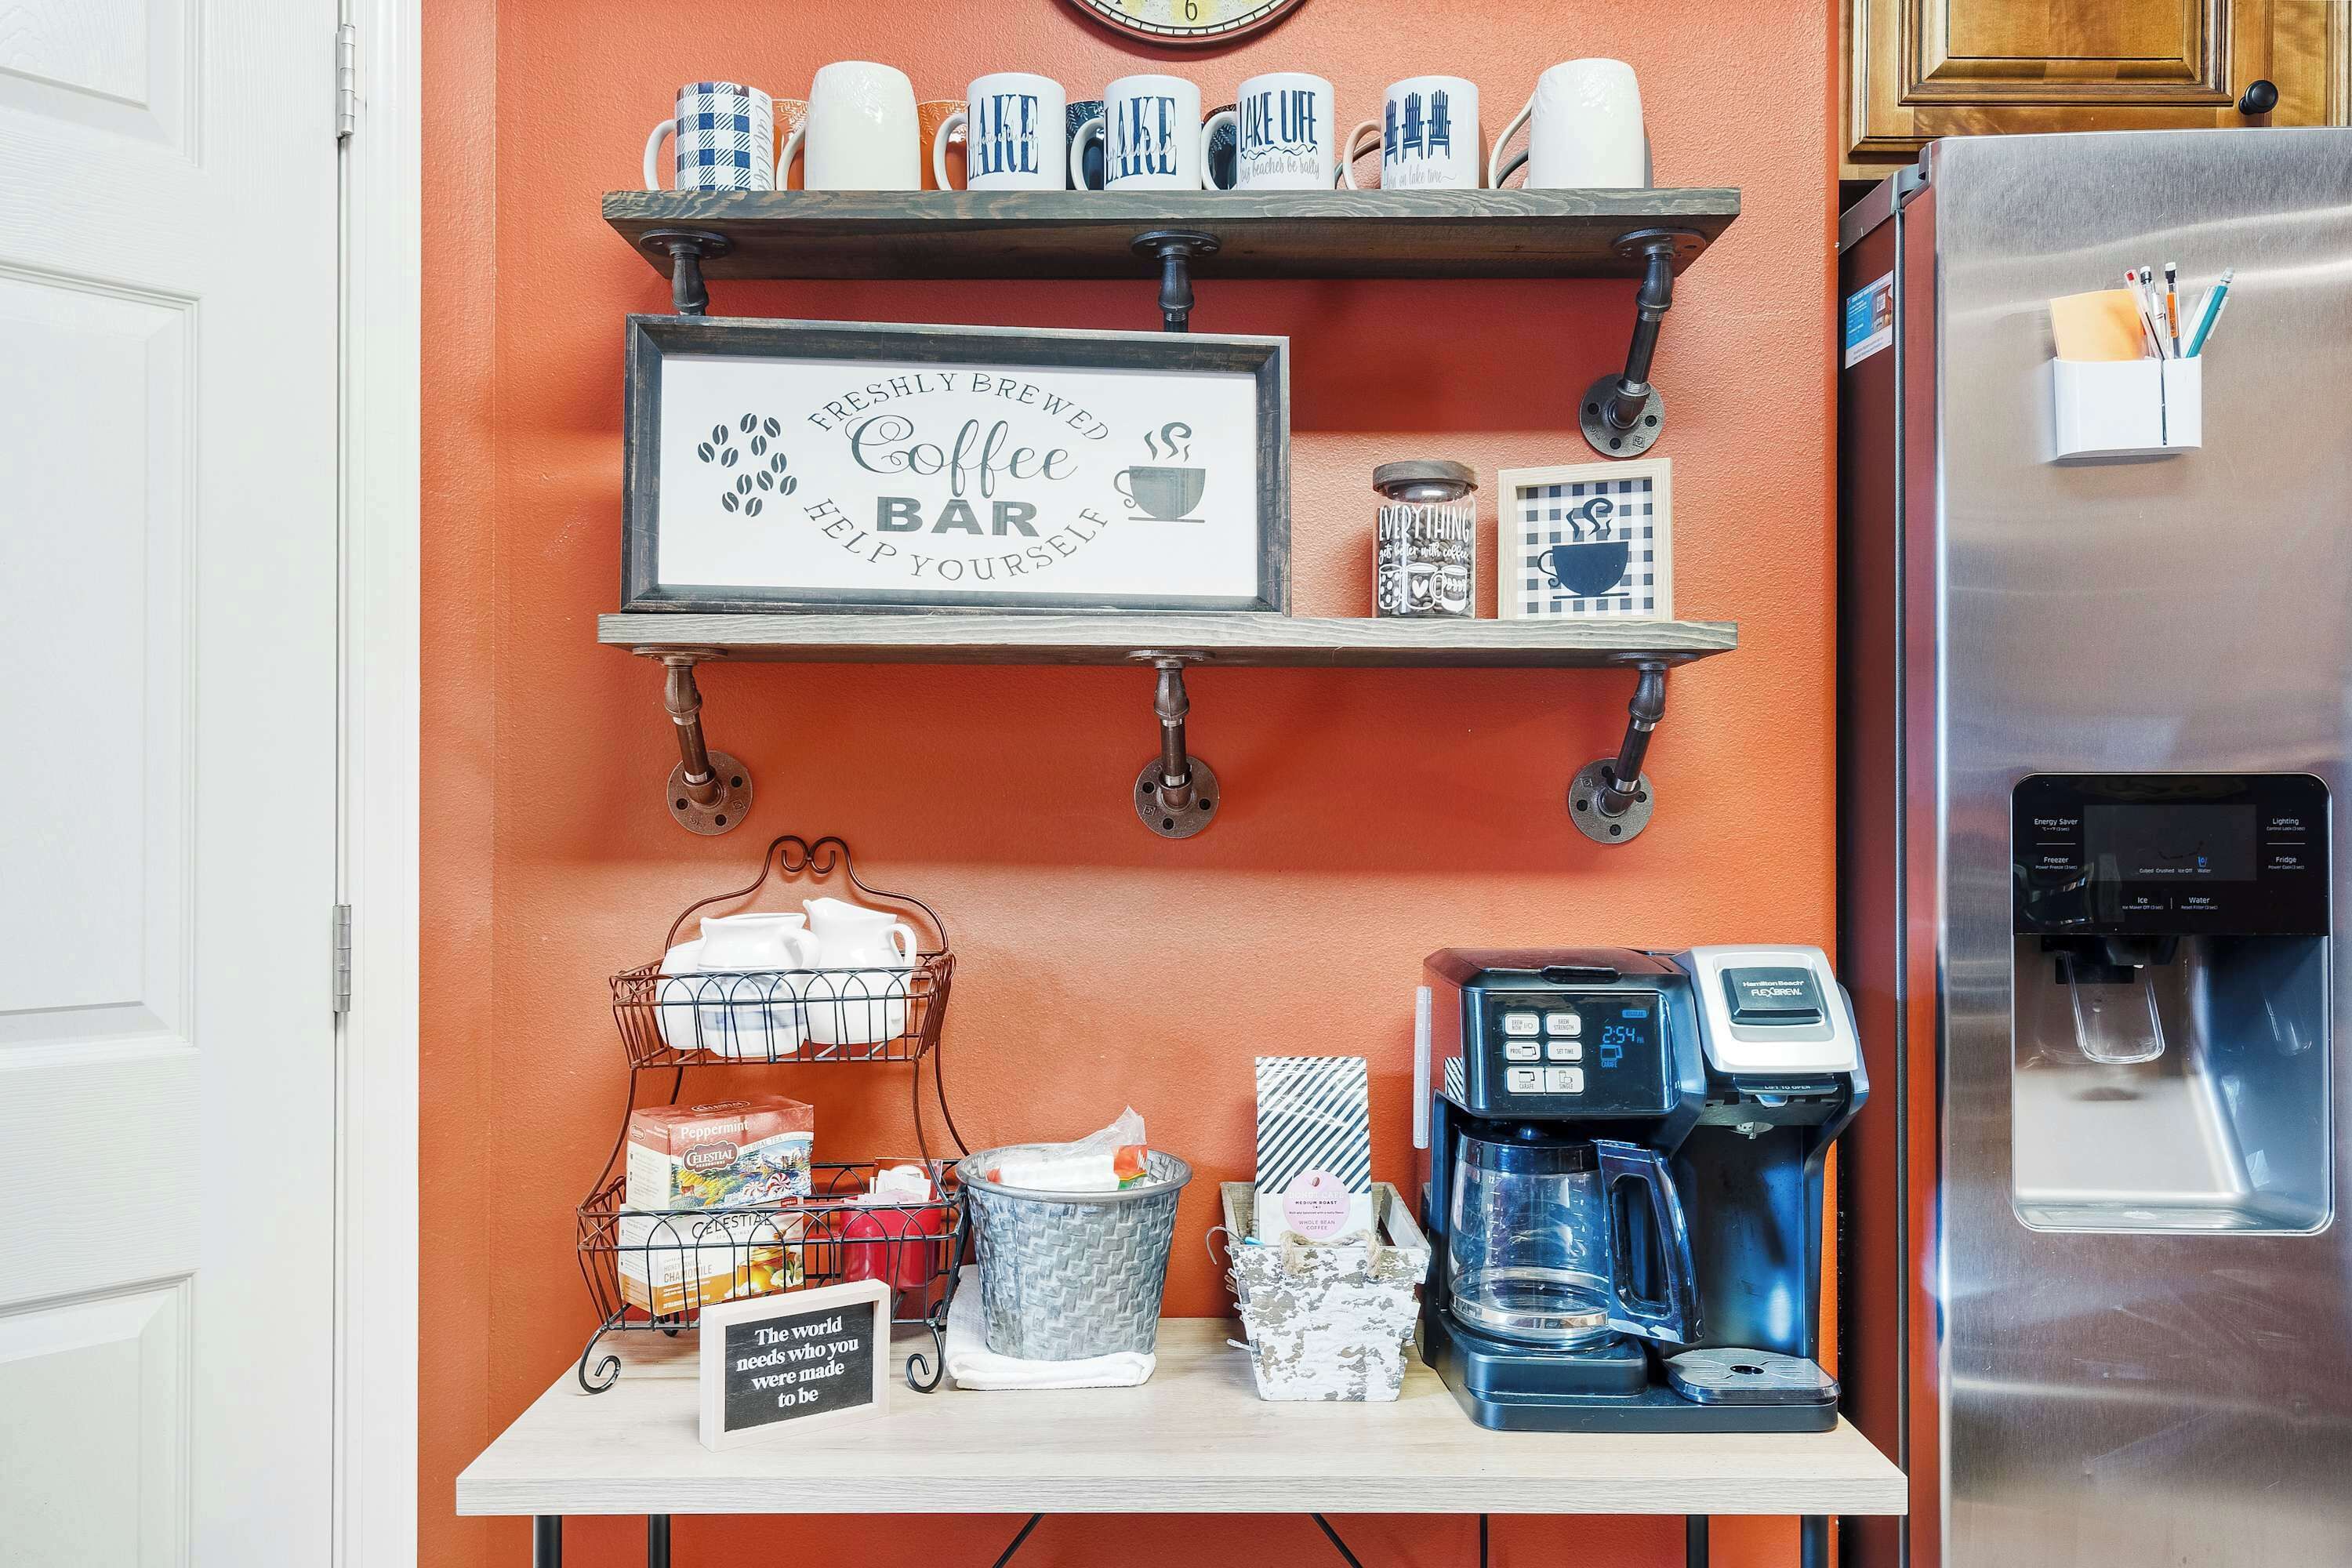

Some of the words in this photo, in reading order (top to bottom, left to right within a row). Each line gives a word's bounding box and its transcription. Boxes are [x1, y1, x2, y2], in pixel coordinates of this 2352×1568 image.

[1185, 0, 1197, 20] 6
[968, 94, 1039, 181] LAKE
[1240, 92, 1274, 153] LAKE
[1281, 90, 1318, 145] LIFE
[1104, 96, 1176, 186] LAKE
[1287, 156, 1298, 172] be
[808, 373, 958, 432] FRESHLY
[972, 372, 1109, 441] BREWED
[845, 415, 1078, 499] Coffee
[877, 496, 1040, 537] BAR
[1378, 504, 1470, 543] EVERYTHING
[804, 499, 897, 564] HELP
[909, 508, 1109, 581] YOURSELF
[1378, 543, 1393, 564] gets
[1394, 542, 1420, 557] better
[1421, 540, 1443, 558] with
[1443, 543, 1469, 561] coffee
[1602, 1026, 1635, 1044] 2:54
[681, 1120, 750, 1140] Peppermint
[687, 1149, 735, 1167] CELESTIAL
[754, 1327, 789, 1346] The
[791, 1316, 844, 1338] world
[735, 1348, 786, 1372] needs
[786, 1342, 826, 1362] who
[827, 1338, 859, 1361] you
[751, 1371, 797, 1390] were
[798, 1359, 845, 1382] made
[778, 1392, 796, 1408] to
[798, 1387, 819, 1404] be
